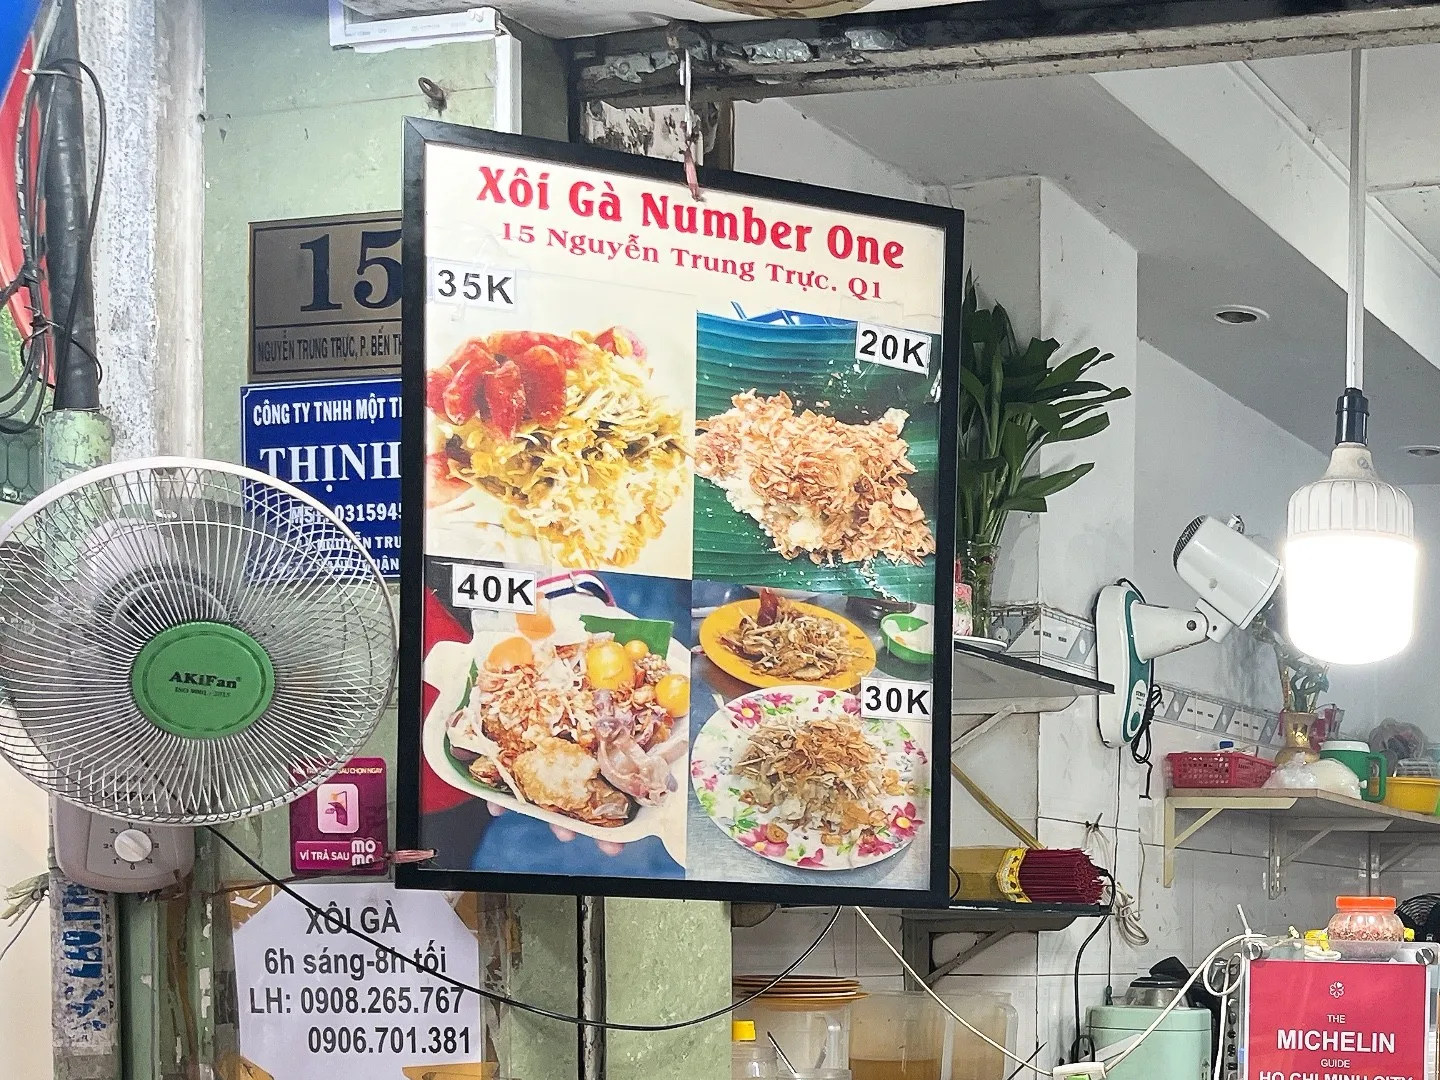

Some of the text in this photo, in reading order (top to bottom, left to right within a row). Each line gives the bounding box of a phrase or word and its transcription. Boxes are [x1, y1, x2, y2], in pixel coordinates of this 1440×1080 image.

[477, 166, 904, 268] Xôi Gà Number One
[300, 229, 401, 312] 15
[503, 223, 536, 244] 15
[547, 228, 659, 263] Nguyễn
[671, 248, 755, 281] Trung
[848, 277, 882, 300] Q1
[437, 269, 513, 305] 35K
[297, 338, 328, 360] TRUNG
[360, 336, 368, 357] P.
[371, 325, 390, 357] BẾN
[859, 330, 926, 367] 20K
[253, 399, 290, 426] CÔNG
[293, 402, 311, 423] TY
[314, 400, 352, 422] TNHH
[355, 393, 386, 424] MỘT
[259, 441, 402, 493] THỊNH
[458, 572, 534, 606] 40K
[865, 685, 930, 716] 30K
[311, 848, 329, 860] TRẢ
[331, 852, 349, 860] SAU
[305, 900, 401, 934] XÔI GÀ
[264, 940, 446, 980] 6h sáng-8h tối
[250, 987, 464, 1013] LH: 0908.265.767
[1327, 1014, 1346, 1023] THE
[308, 1026, 470, 1053] 0906.701.381
[1277, 1029, 1395, 1053] MICHELIN
[1320, 1058, 1350, 1069] GUIDE
